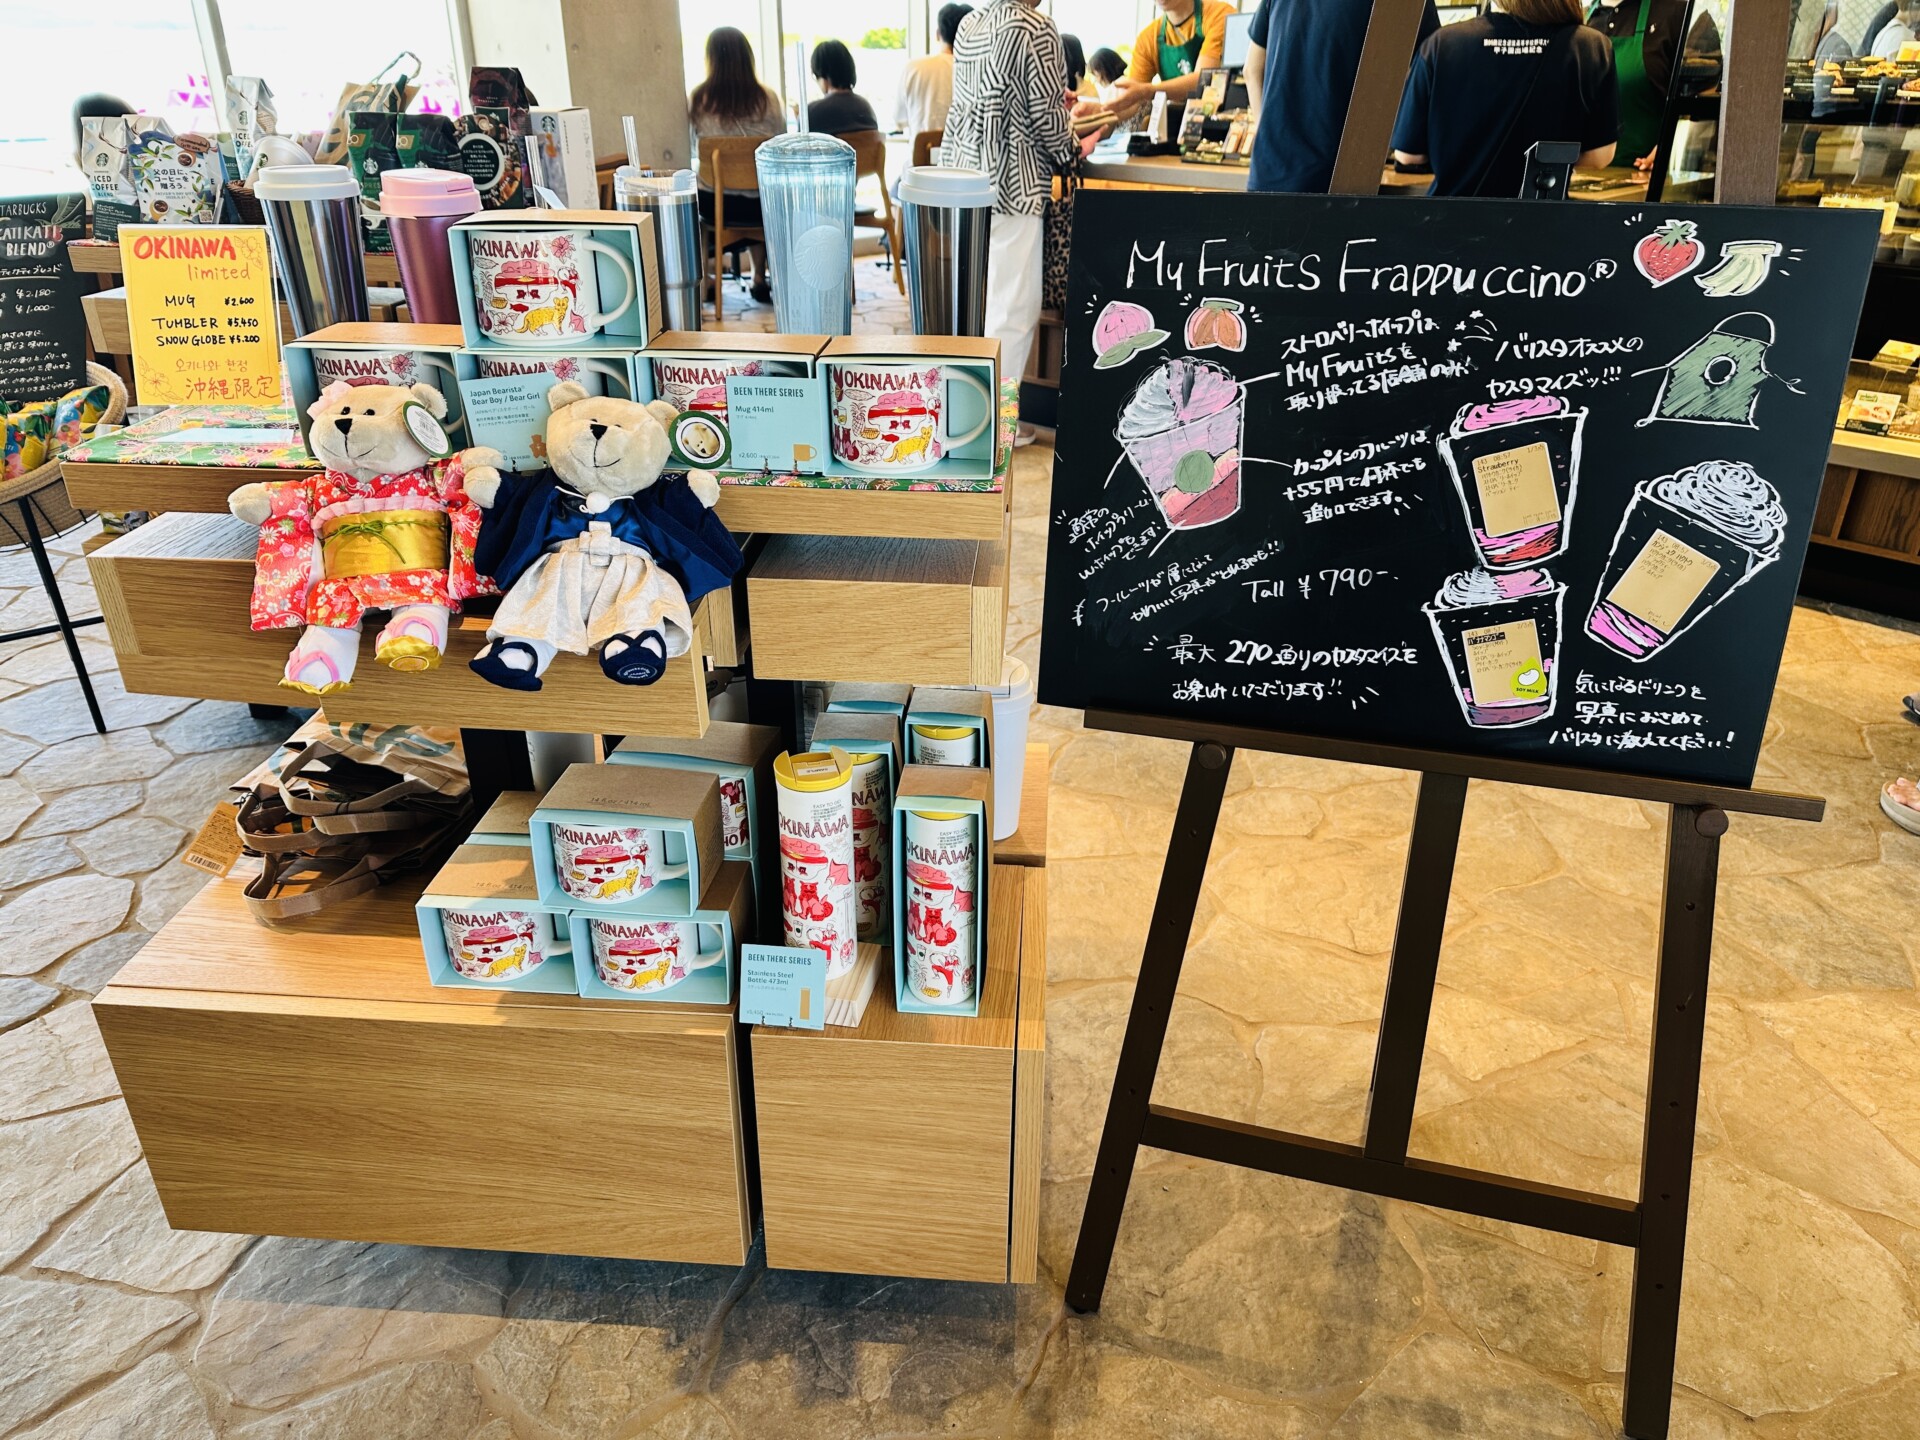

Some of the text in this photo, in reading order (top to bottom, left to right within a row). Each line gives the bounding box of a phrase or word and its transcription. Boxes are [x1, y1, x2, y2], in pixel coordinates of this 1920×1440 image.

[0, 202, 47, 216] TARBUCKS
[133, 235, 237, 261] OKINAWA
[472, 237, 550, 259] OKINAWA
[187, 263, 251, 281] limited
[1124, 239, 1182, 291] My
[1198, 238, 1321, 291] Fruits
[165, 295, 196, 308] MUG
[151, 317, 219, 330] TUMBLER
[156, 335, 189, 347] SNOW
[191, 335, 226, 347] GLOBE
[175, 357, 248, 373] 오키나와 한정
[315, 356, 388, 377] OKINAWA
[480, 358, 548, 378] OKINAWA
[663, 365, 739, 389] OKINAWA
[843, 370, 922, 393] OKINAWA
[185, 375, 280, 401] 沖縄限定
[470, 389, 491, 398] Japan
[733, 386, 804, 398] BEEN THERE SERIES
[489, 396, 503, 404] Boy
[735, 405, 774, 413] Mug 414ml
[1477, 458, 1519, 474] Strawberry
[1241, 579, 1284, 603] Tall
[554, 823, 623, 846] OKINAWA
[906, 836, 976, 866] OKINAWA
[443, 908, 509, 928] OKINAWA
[591, 917, 655, 939] OKINAWA
[748, 953, 812, 966] BEEN THERE SERIES
[747, 969, 794, 979] Stainless Steel
[747, 976, 768, 984] Bottle
